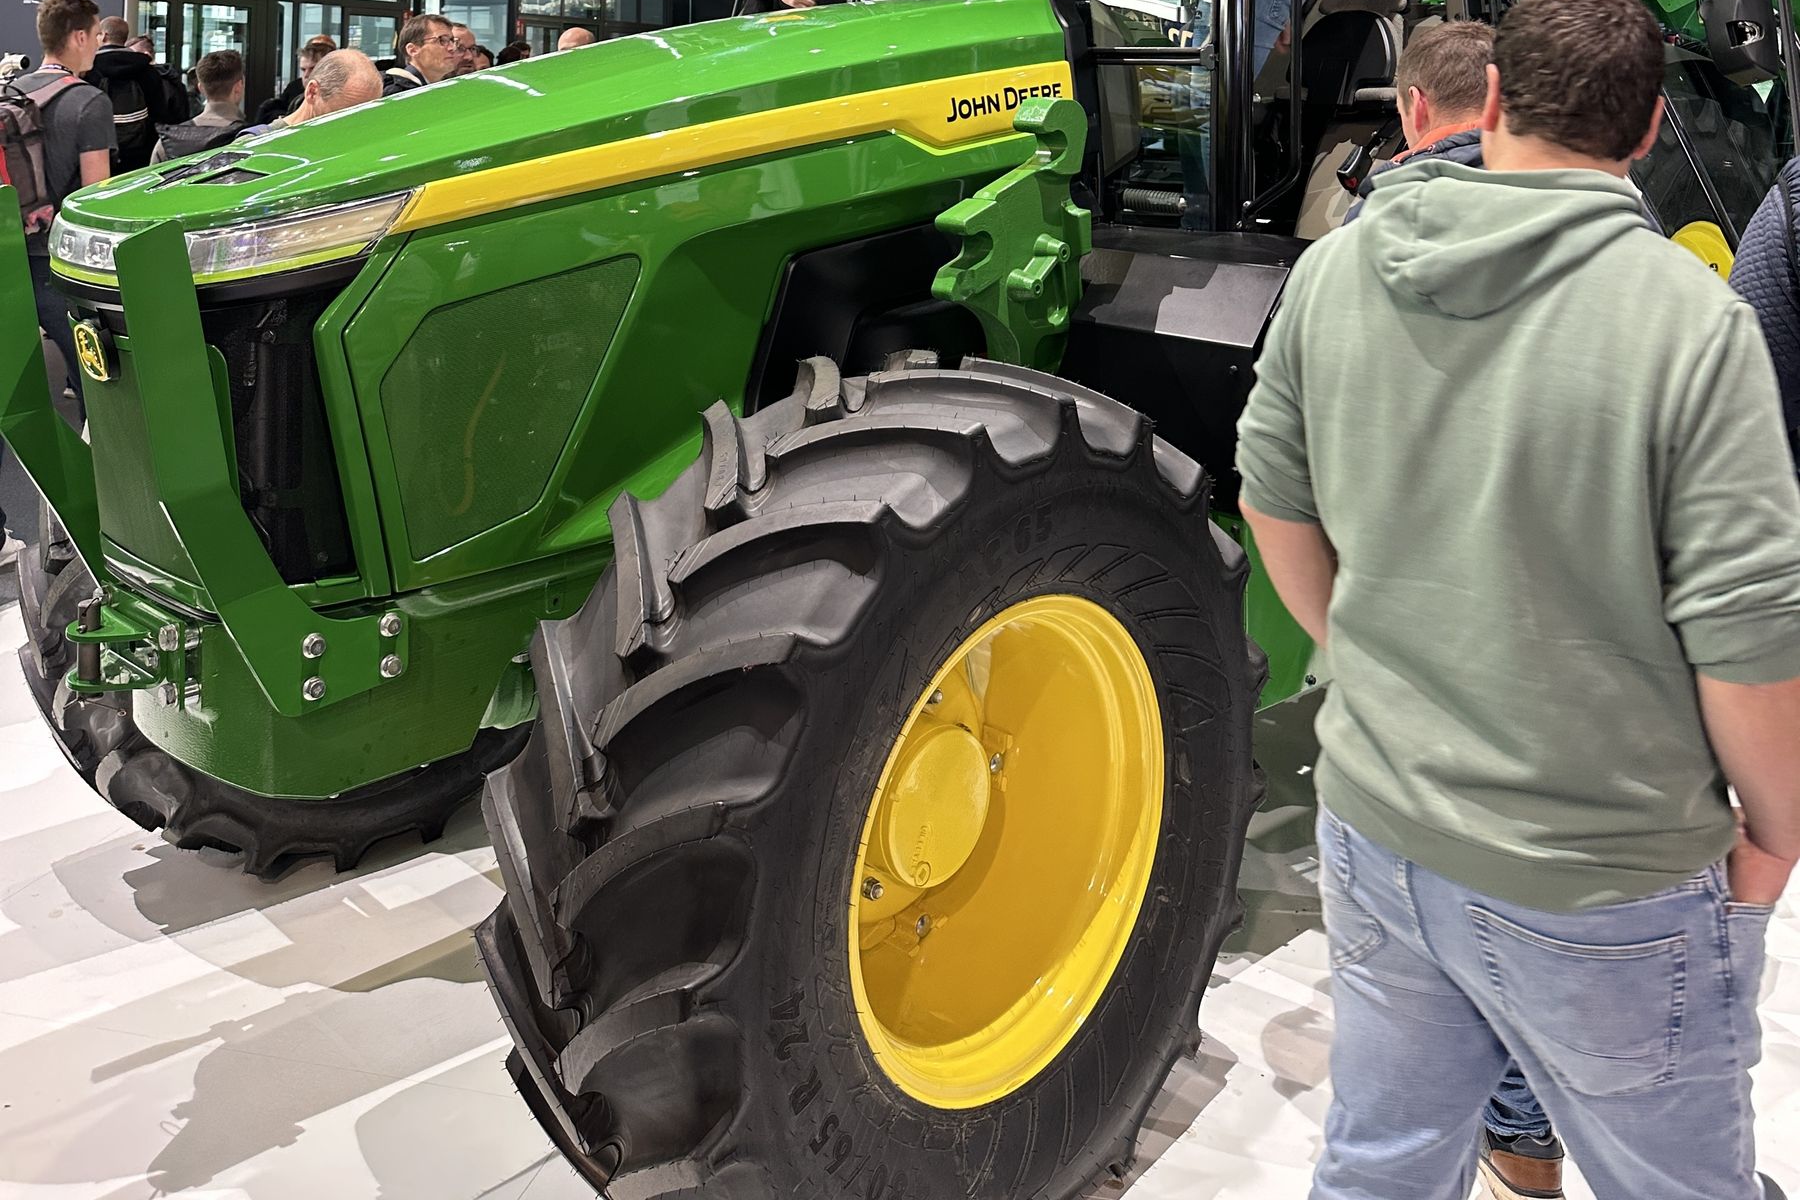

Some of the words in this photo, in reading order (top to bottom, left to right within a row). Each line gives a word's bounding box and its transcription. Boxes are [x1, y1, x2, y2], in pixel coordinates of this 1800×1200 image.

[946, 93, 1001, 123] JOHN
[1003, 82, 1063, 111] DEERE
[769, 988, 811, 1062] 24
[788, 1065, 824, 1117] R
